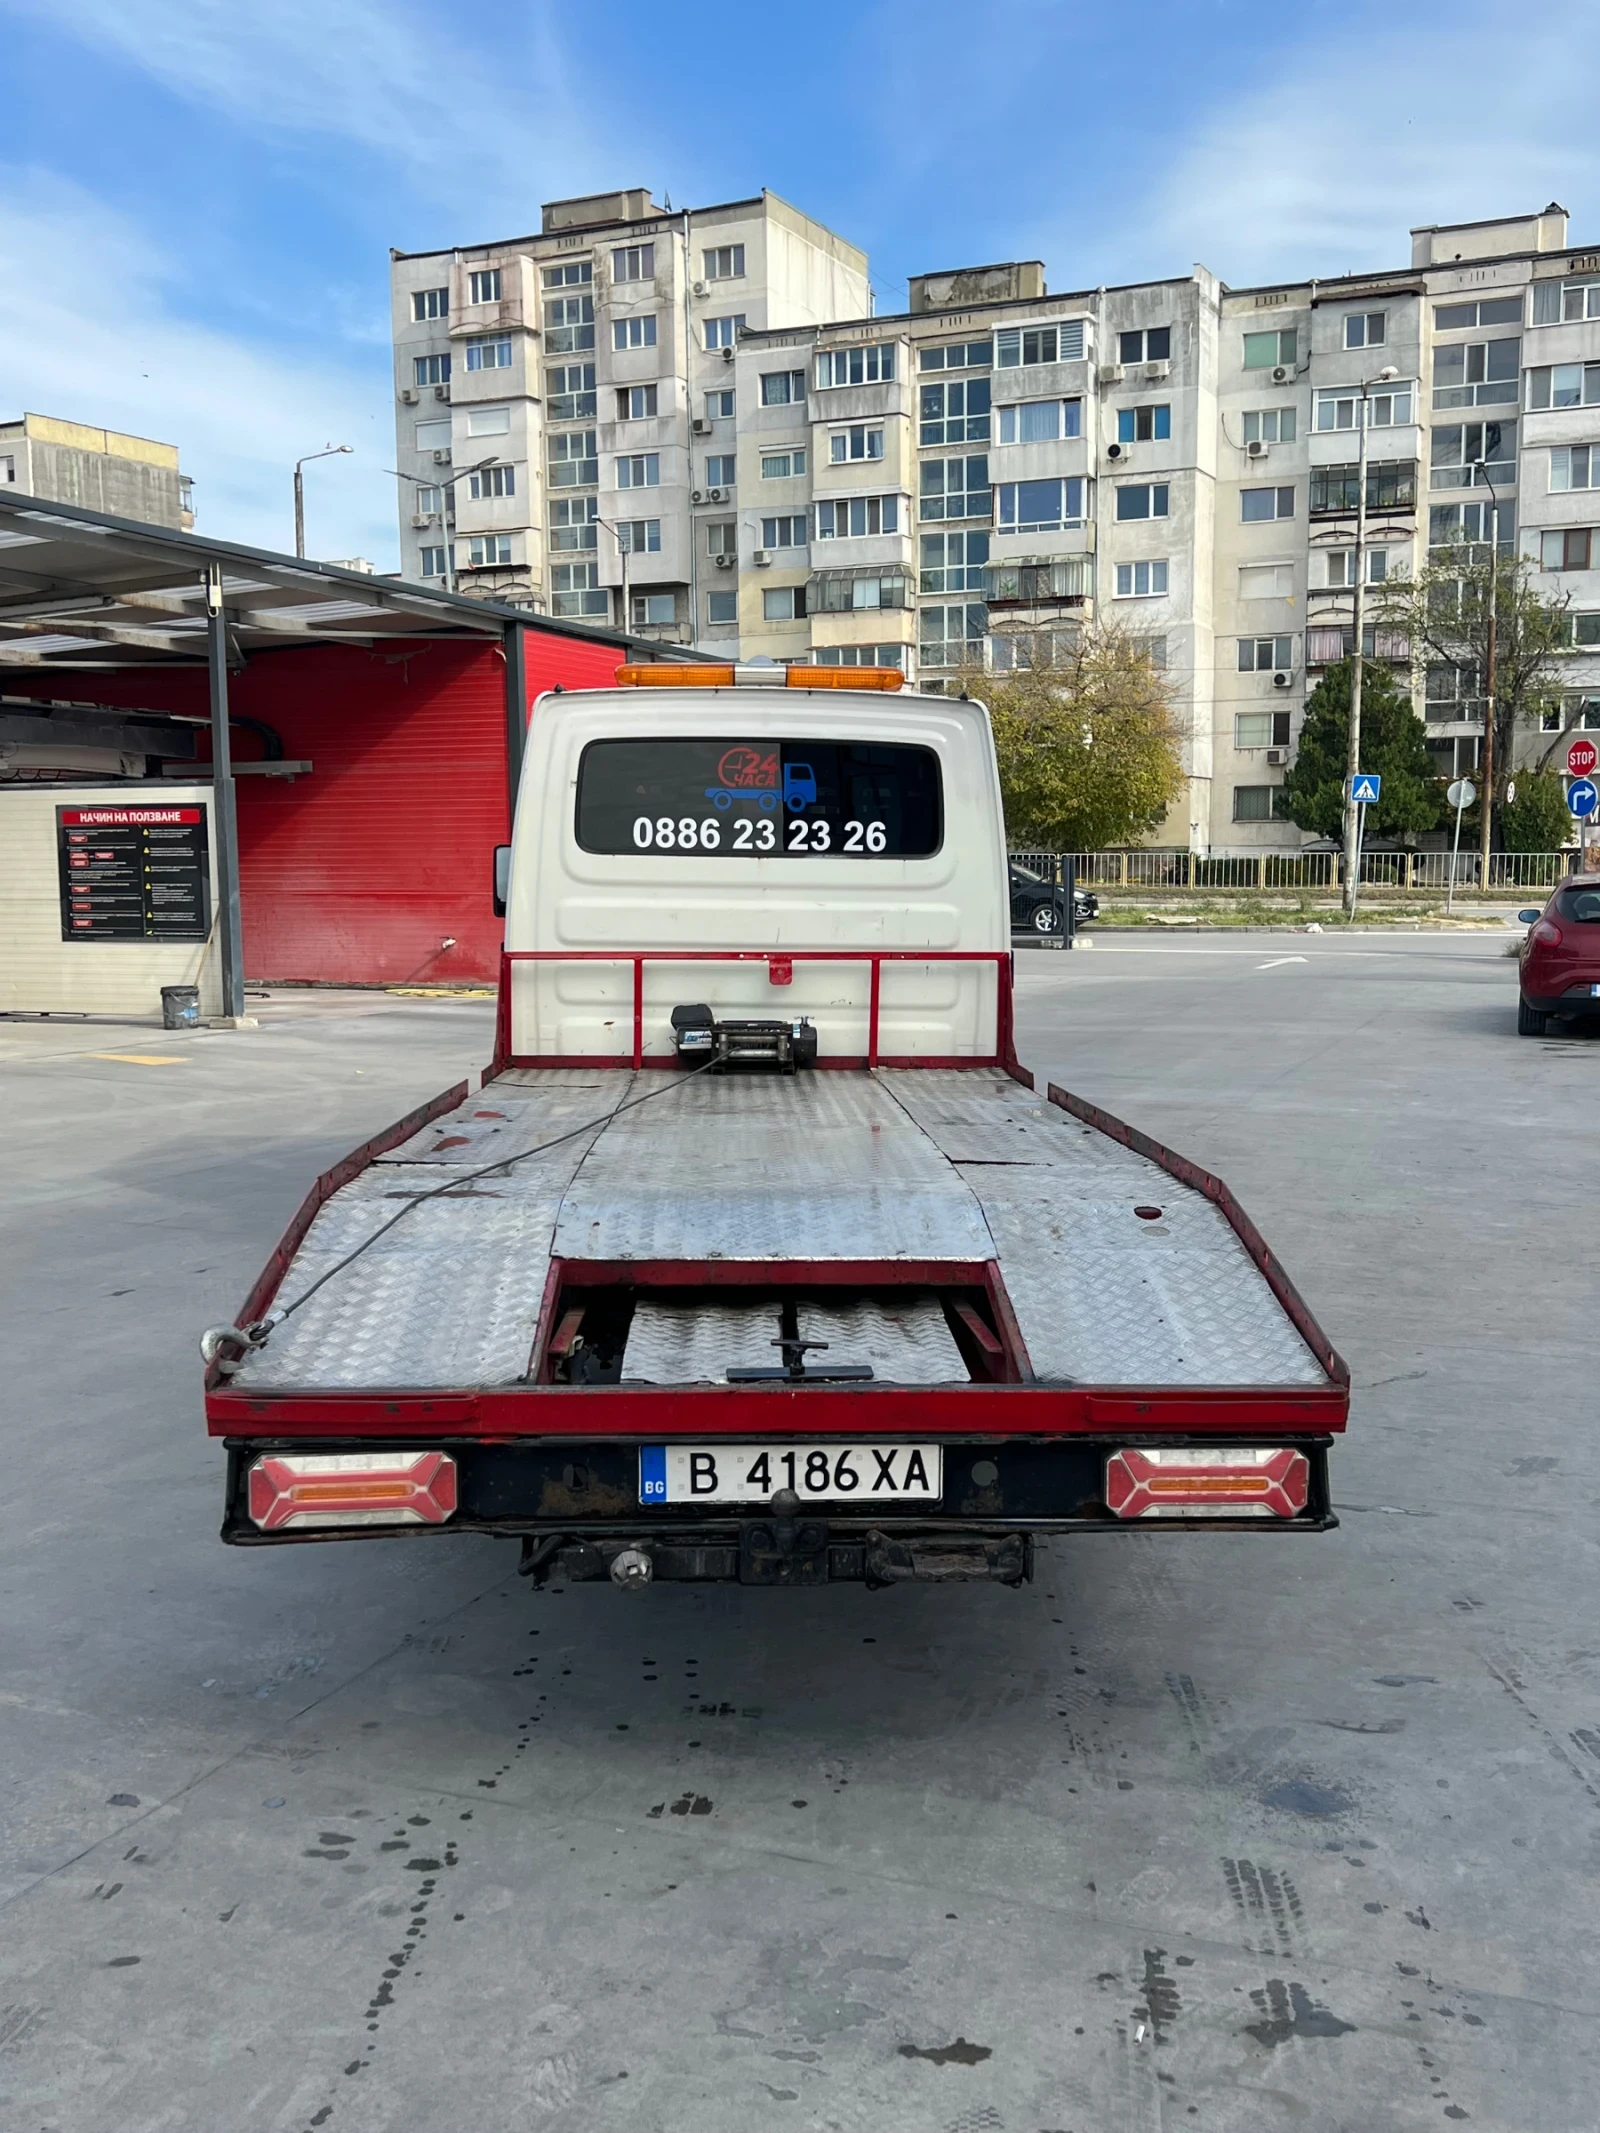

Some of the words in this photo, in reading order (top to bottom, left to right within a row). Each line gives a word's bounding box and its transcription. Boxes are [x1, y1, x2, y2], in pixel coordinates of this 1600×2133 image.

[744, 753, 778, 773] 24
[1570, 751, 1594, 765] STOP
[733, 773, 775, 787] ЧАСА
[80, 812, 114, 823] НАЧИН
[114, 812, 129, 822] НА
[129, 811, 181, 822] ПОЛЗВАНЕ
[633, 817, 721, 849] 0886
[733, 818, 776, 850] 23
[788, 820, 831, 851] 23
[843, 821, 887, 852] 26
[690, 1453, 719, 1494] B
[746, 1450, 859, 1493] 4186
[871, 1449, 930, 1491] XA
[645, 1481, 665, 1494] BG
